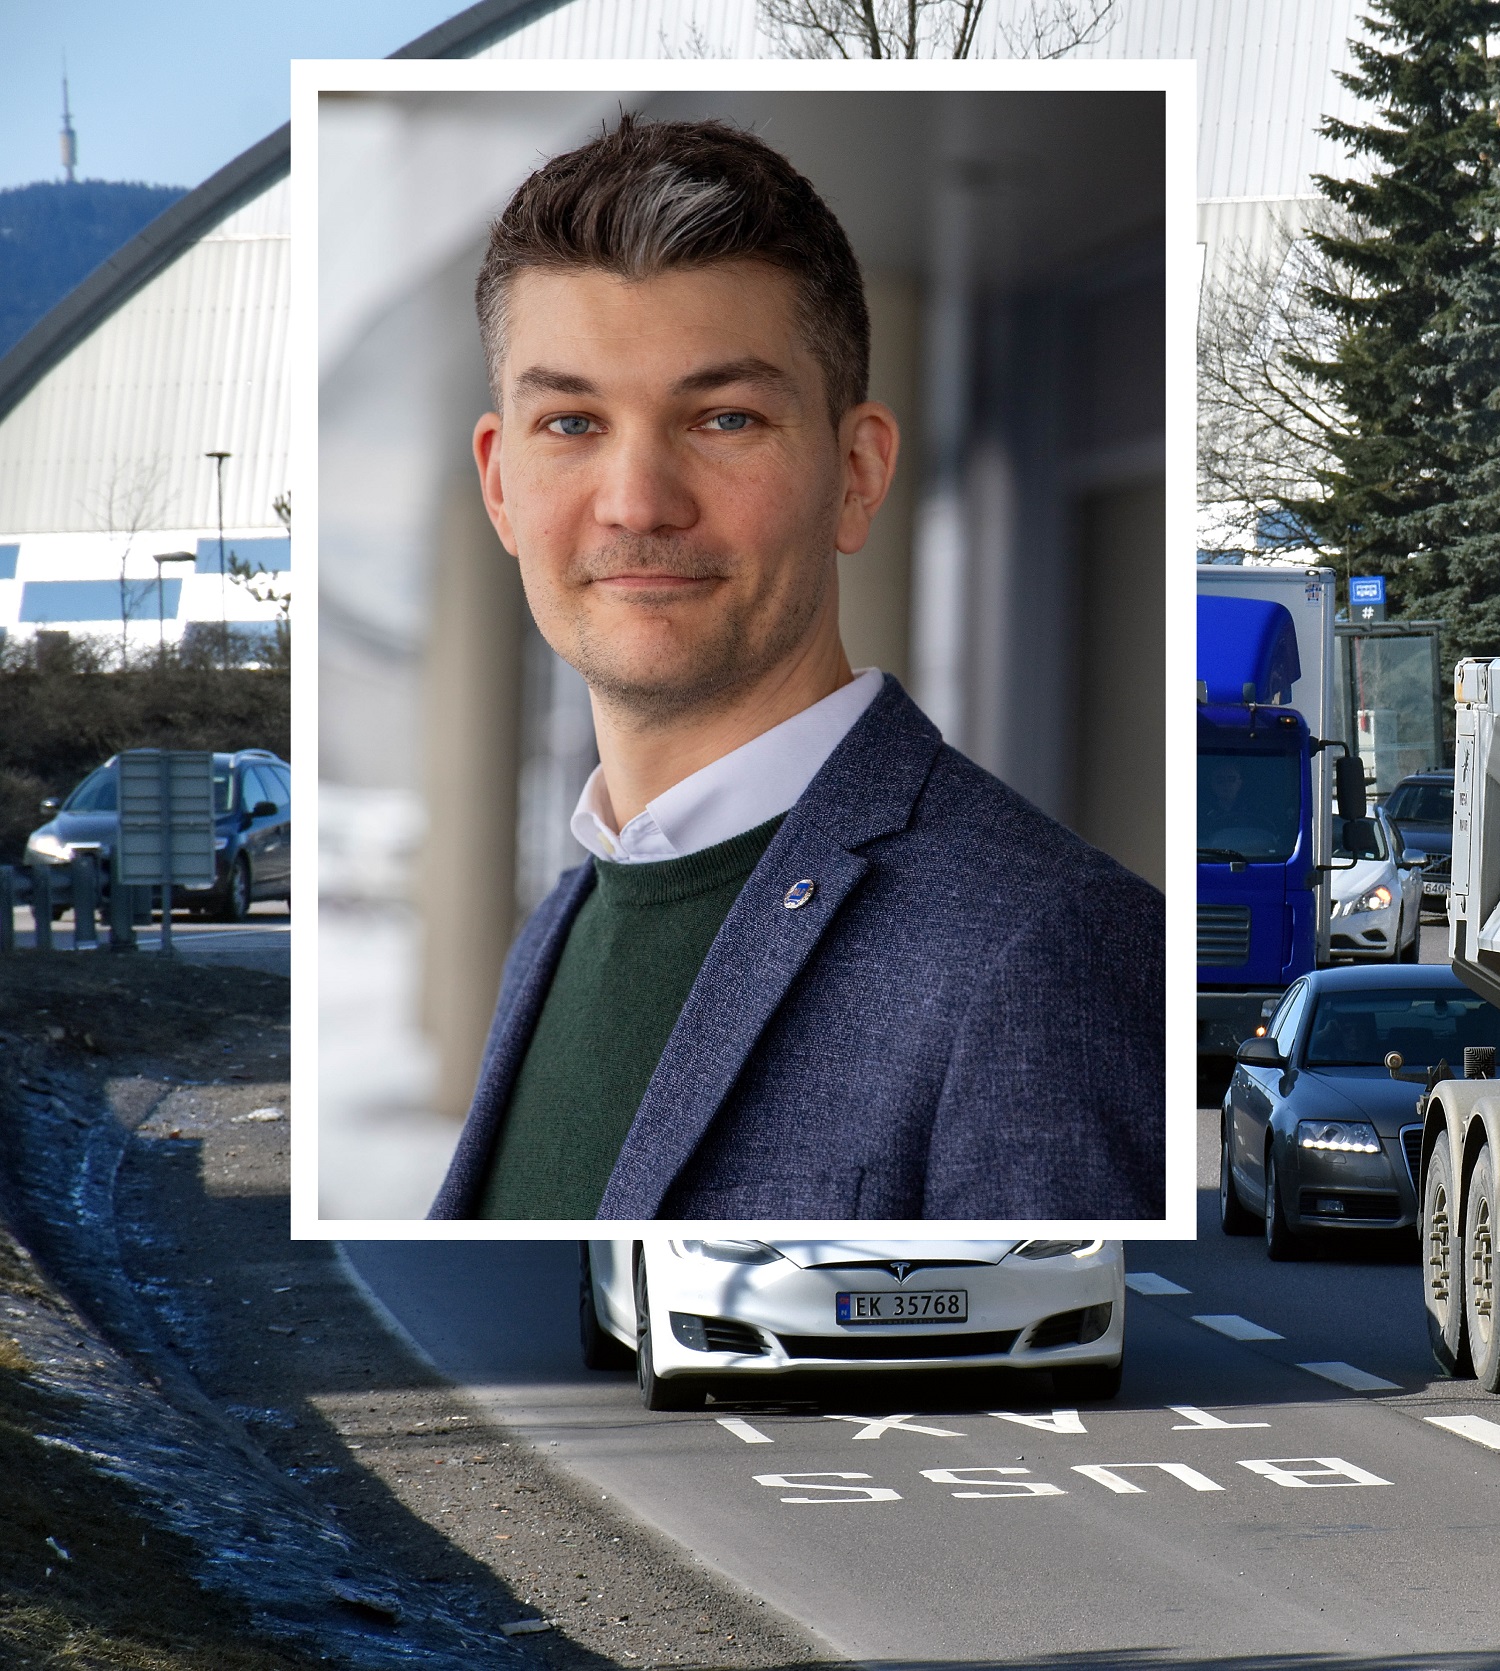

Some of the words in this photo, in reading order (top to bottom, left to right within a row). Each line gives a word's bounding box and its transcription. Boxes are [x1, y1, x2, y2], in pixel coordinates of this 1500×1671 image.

[855, 1296, 881, 1317] EK
[893, 1294, 960, 1316] 35768
[714, 1405, 1270, 1444] TAXI
[753, 1457, 1395, 1504] BUSS
